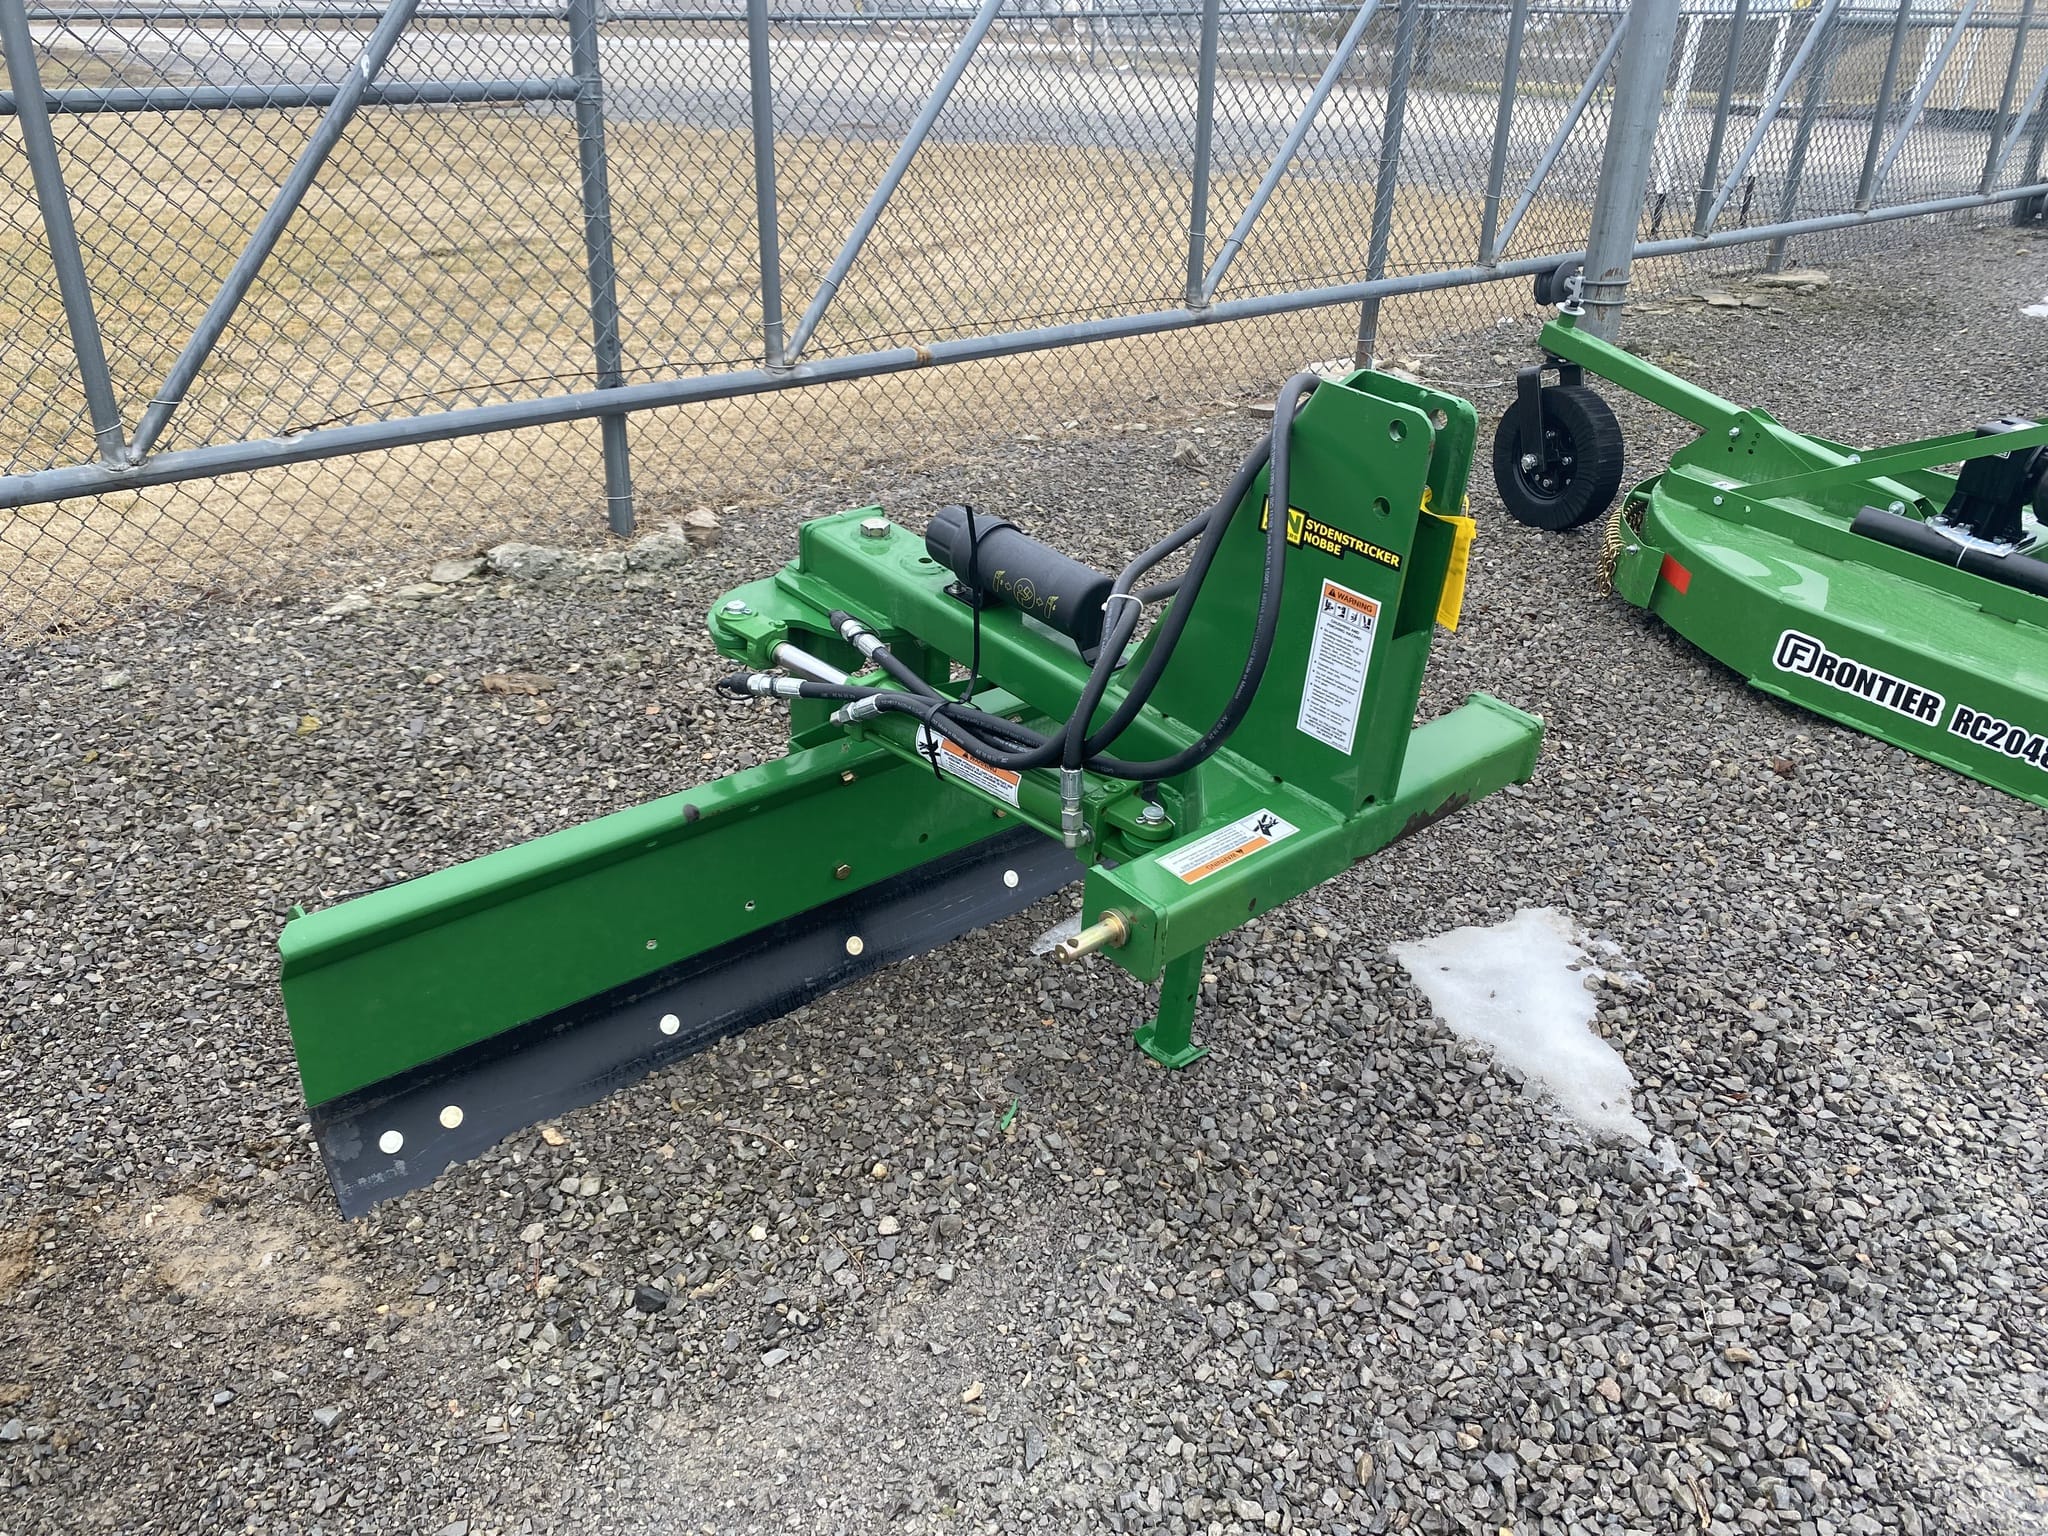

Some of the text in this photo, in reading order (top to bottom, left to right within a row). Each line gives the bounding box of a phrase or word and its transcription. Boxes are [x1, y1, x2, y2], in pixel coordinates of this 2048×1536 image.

[1303, 530, 1342, 556] NOBBE
[1305, 518, 1400, 568] SYDENSTRICKER
[1337, 591, 1373, 613] WARNING
[1776, 633, 1941, 723] FRONTIER
